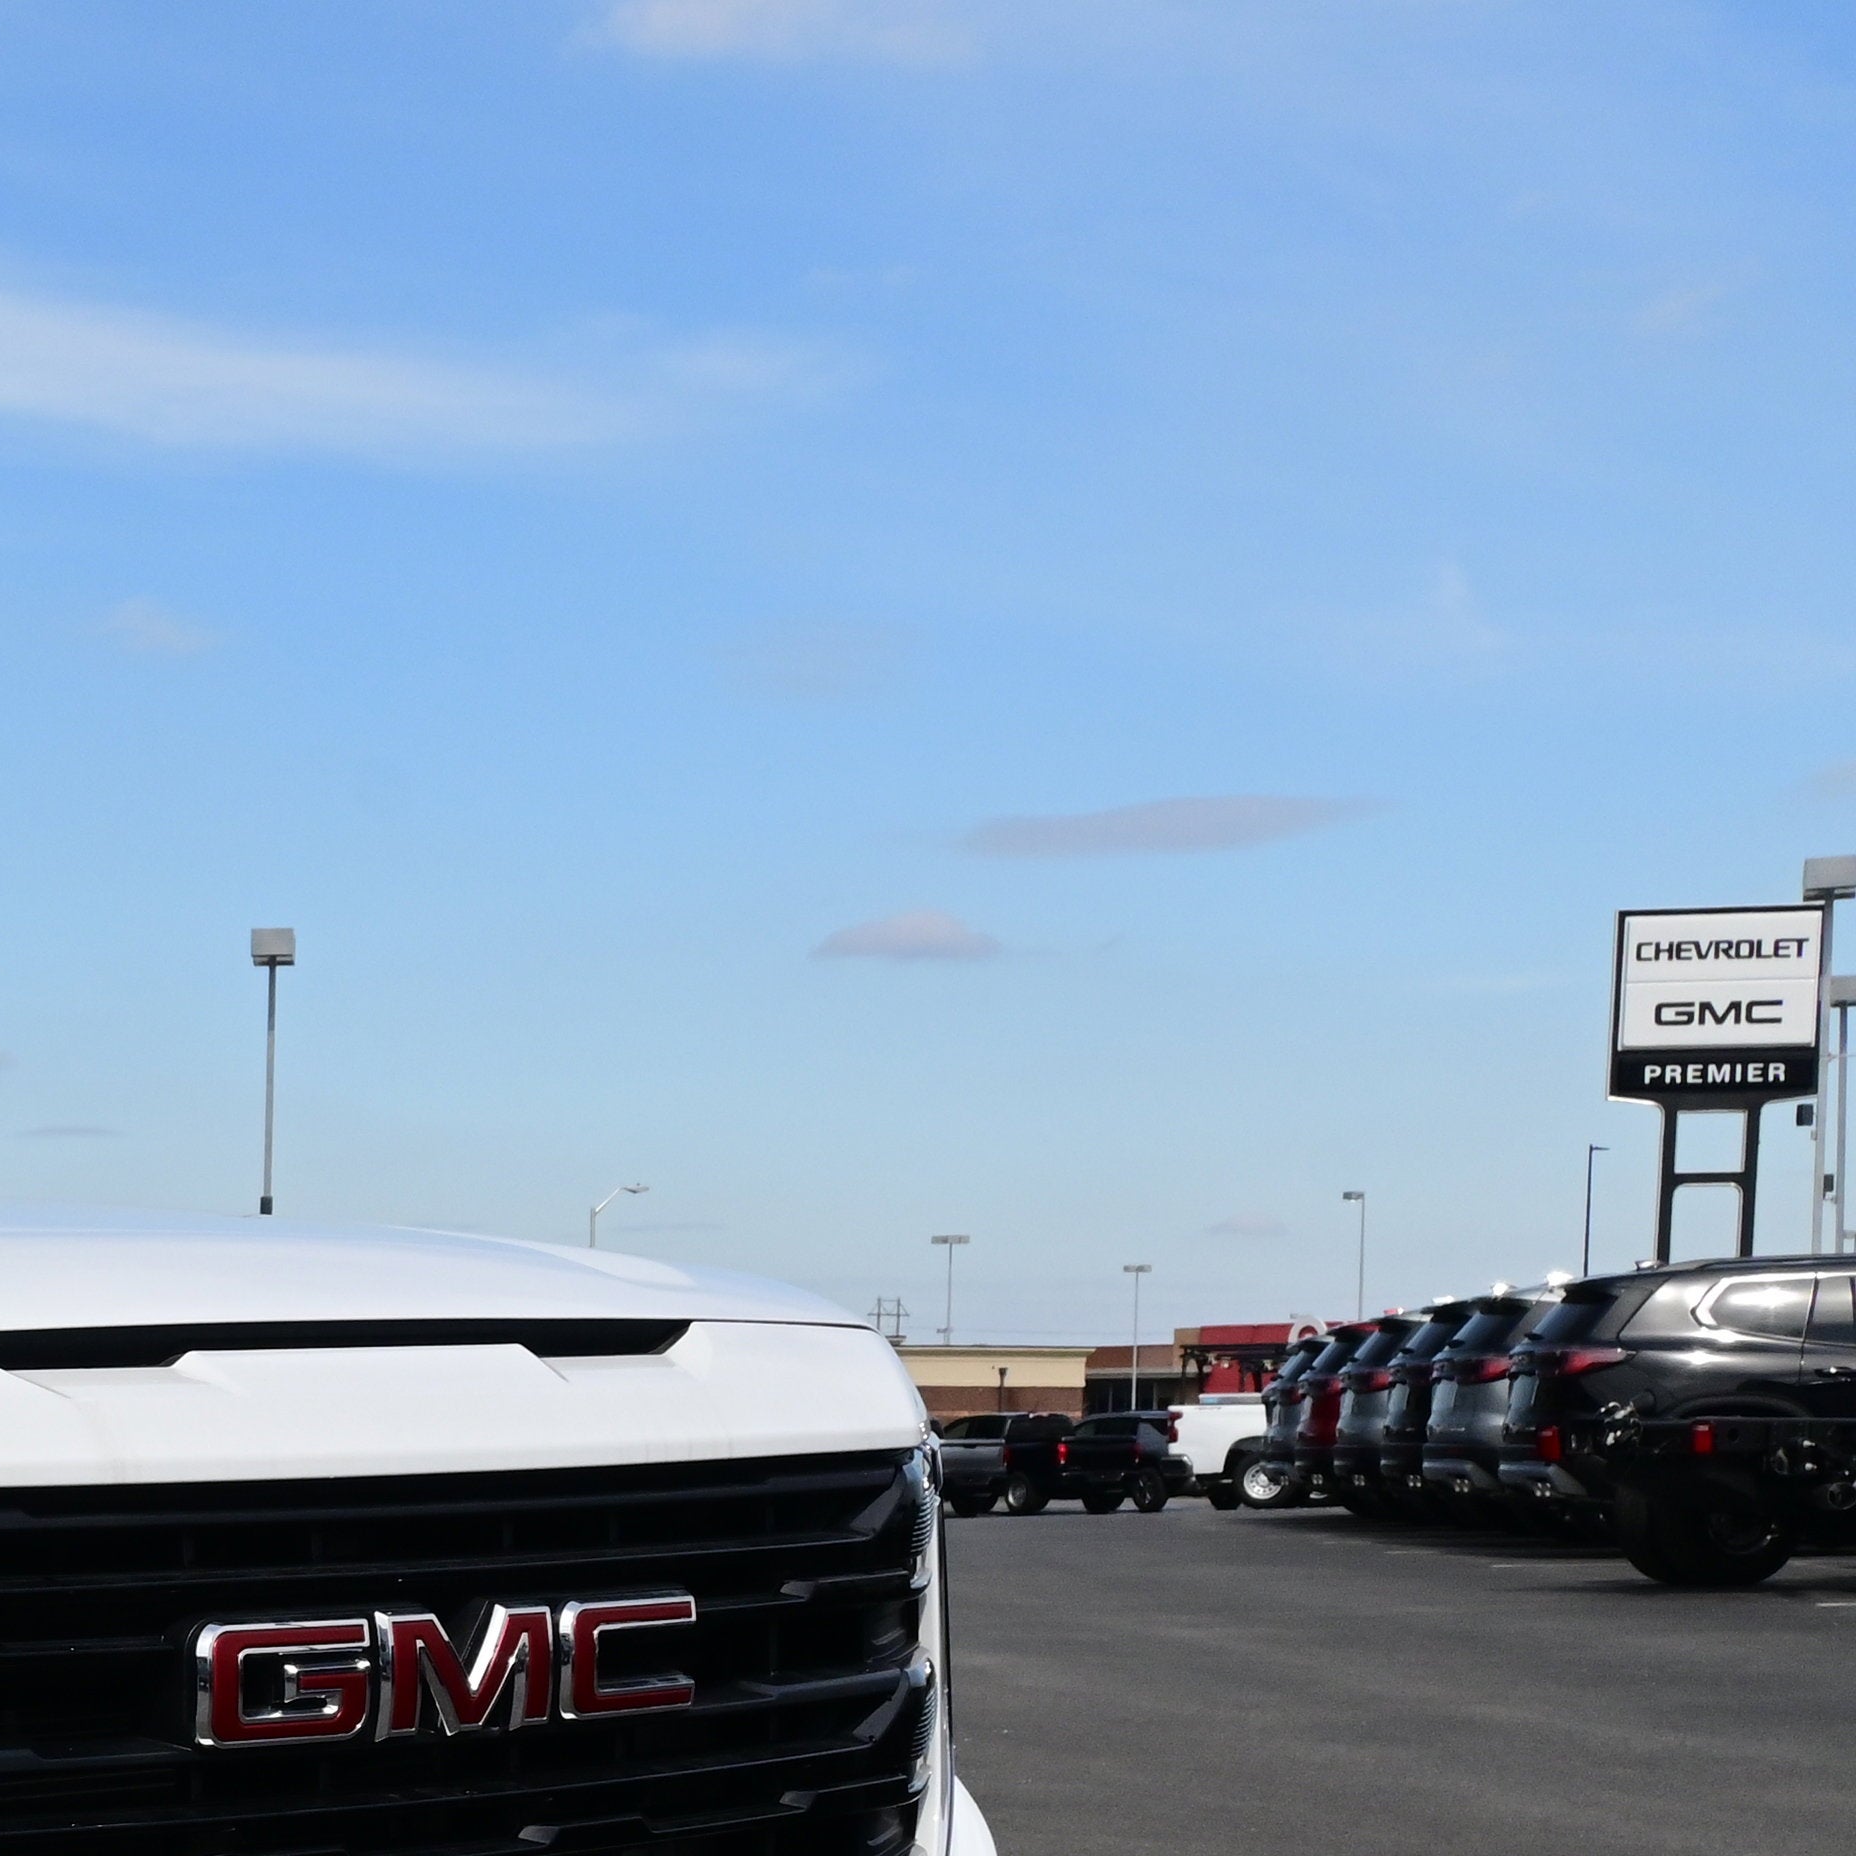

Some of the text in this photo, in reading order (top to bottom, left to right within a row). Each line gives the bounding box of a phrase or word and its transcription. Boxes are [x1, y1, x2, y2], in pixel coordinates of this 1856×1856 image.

[1635, 938, 1809, 962] CHEVROLET
[1654, 1000, 1783, 1026] GMC
[1643, 1063, 1786, 1085] PREMIER
[195, 1595, 697, 1749] GMC
